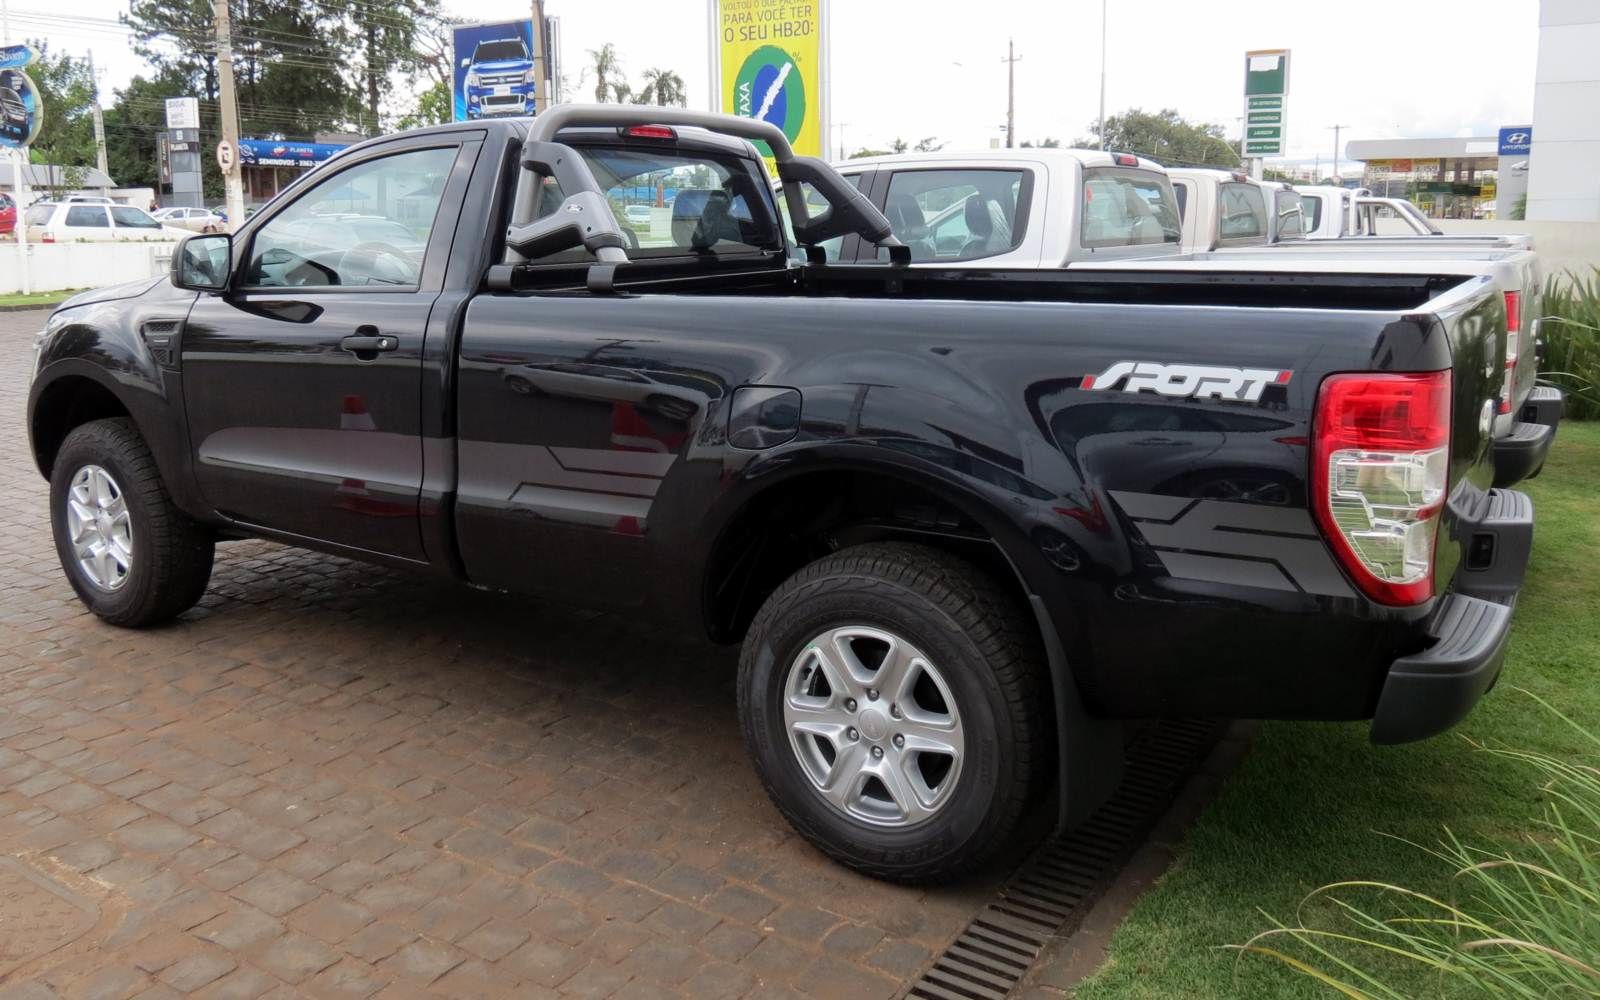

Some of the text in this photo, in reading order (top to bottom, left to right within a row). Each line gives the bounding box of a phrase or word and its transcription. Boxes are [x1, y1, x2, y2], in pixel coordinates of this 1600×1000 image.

[723, 5, 812, 25] PARA VOCÊ TER
[724, 20, 814, 42] O SEU HB20:
[739, 81, 751, 118] TAXA
[258, 158, 295, 167] SEMINOVOS
[1093, 361, 1280, 402] SPORT
